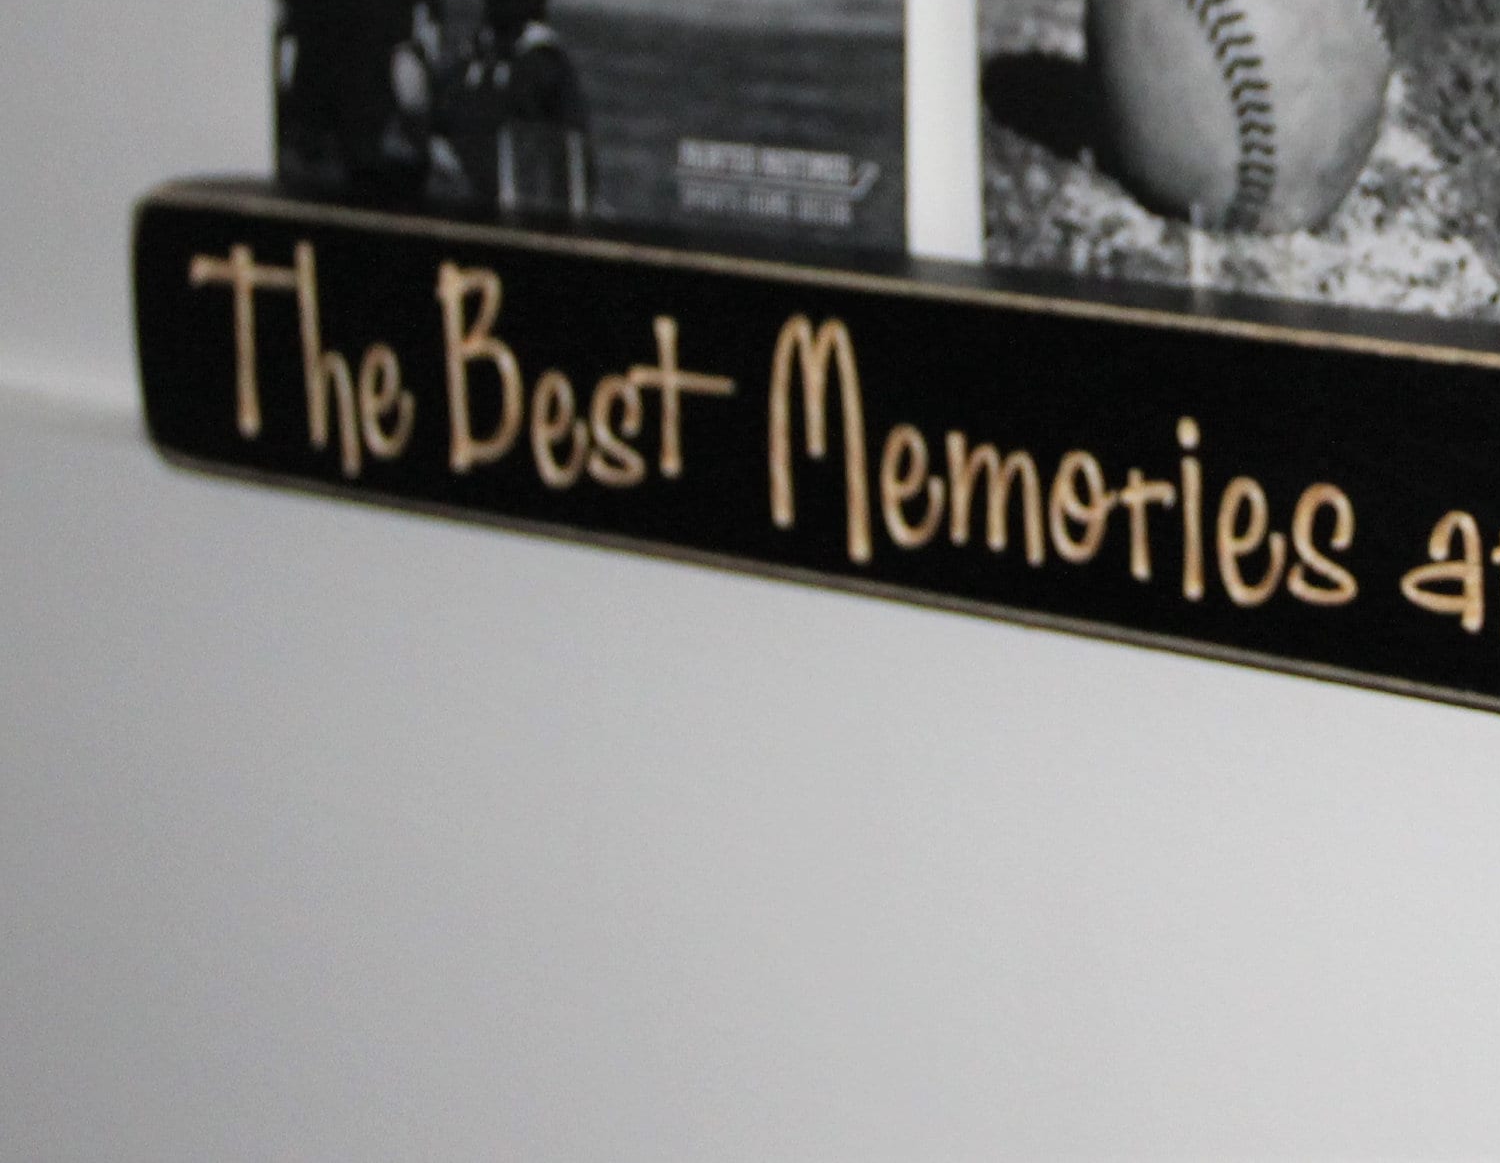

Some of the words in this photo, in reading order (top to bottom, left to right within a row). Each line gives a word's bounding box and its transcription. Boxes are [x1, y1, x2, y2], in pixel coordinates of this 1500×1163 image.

[189, 242, 414, 474] The
[435, 261, 734, 486] Best
[767, 314, 1360, 607] Memories
